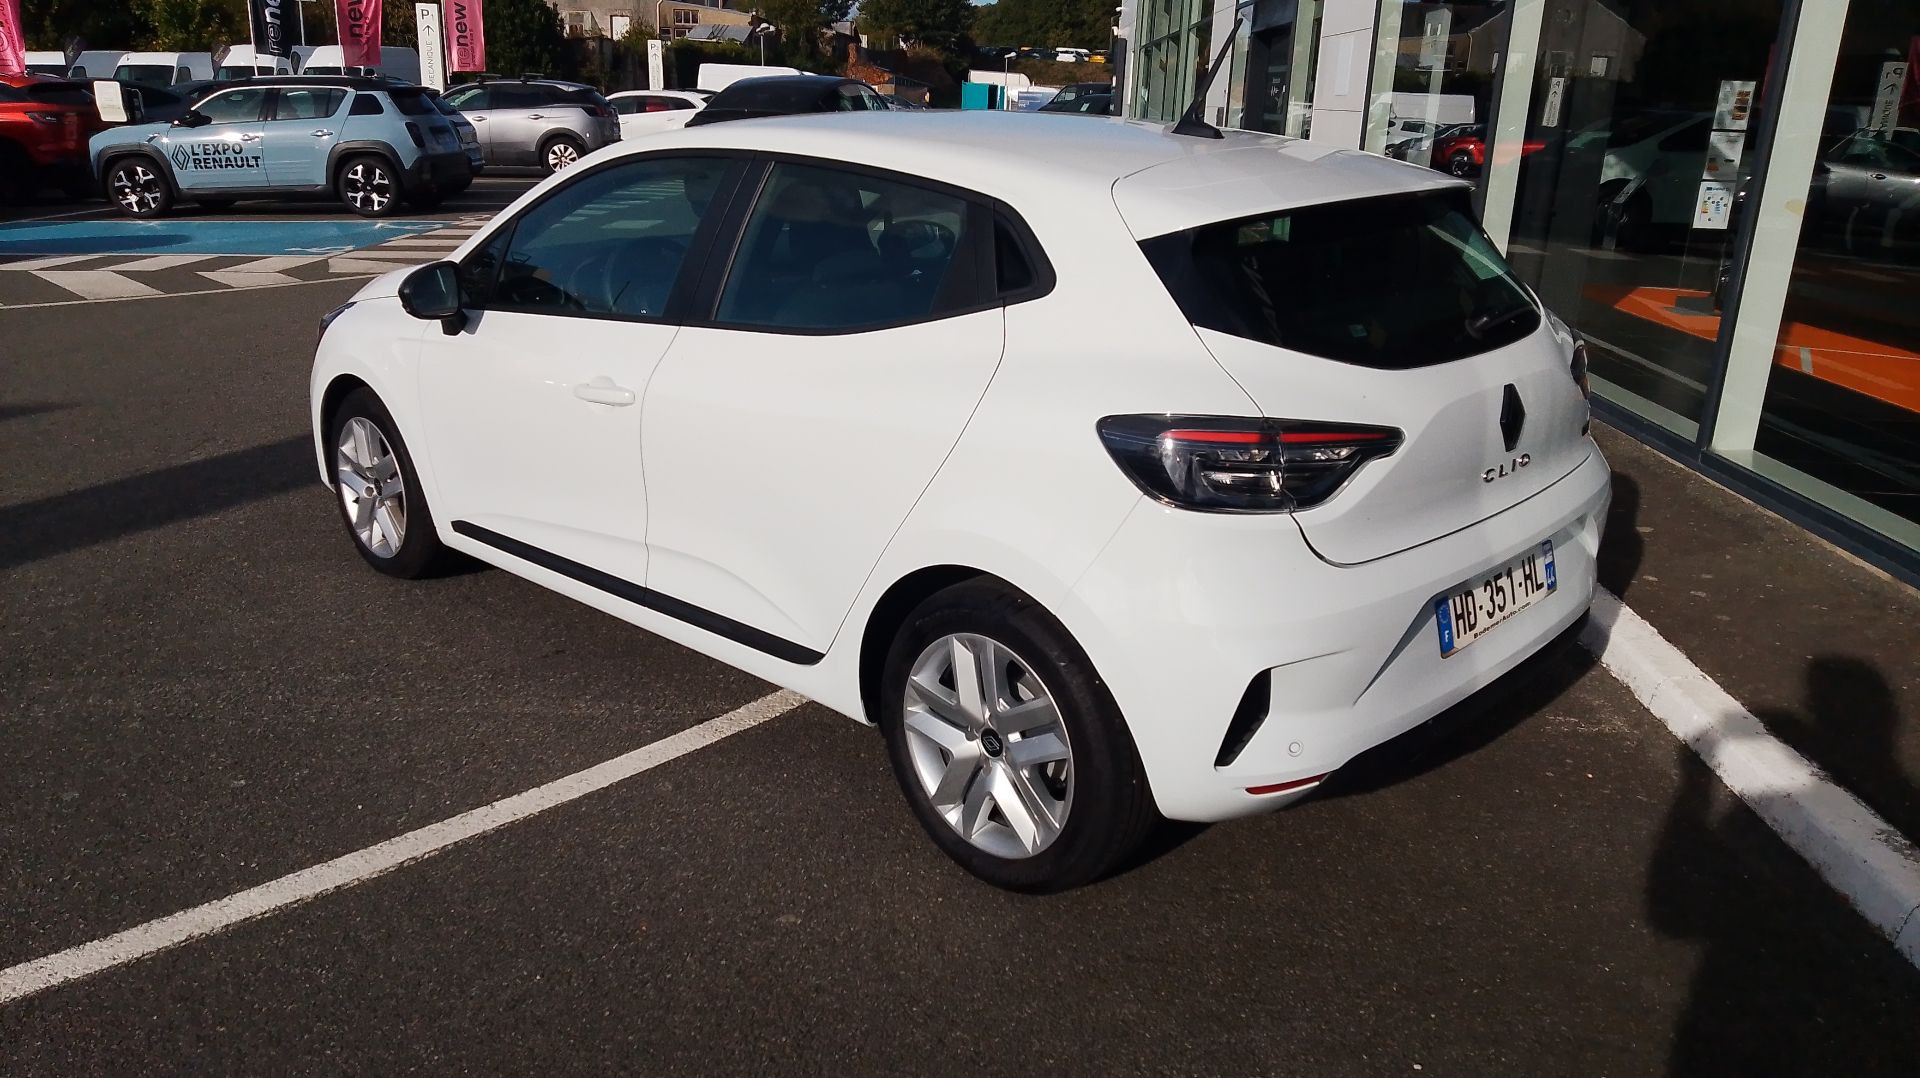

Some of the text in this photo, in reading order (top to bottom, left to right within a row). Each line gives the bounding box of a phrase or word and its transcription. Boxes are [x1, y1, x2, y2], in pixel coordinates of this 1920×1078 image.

[453, 1, 471, 68] renew
[190, 143, 244, 157] L'EXPO
[192, 155, 262, 170] RENAULT
[1480, 453, 1531, 484] CLIO
[1444, 630, 1450, 643] F
[1452, 553, 1545, 640] HD-351-HL
[1473, 601, 1532, 640] BodemerAuto.com
